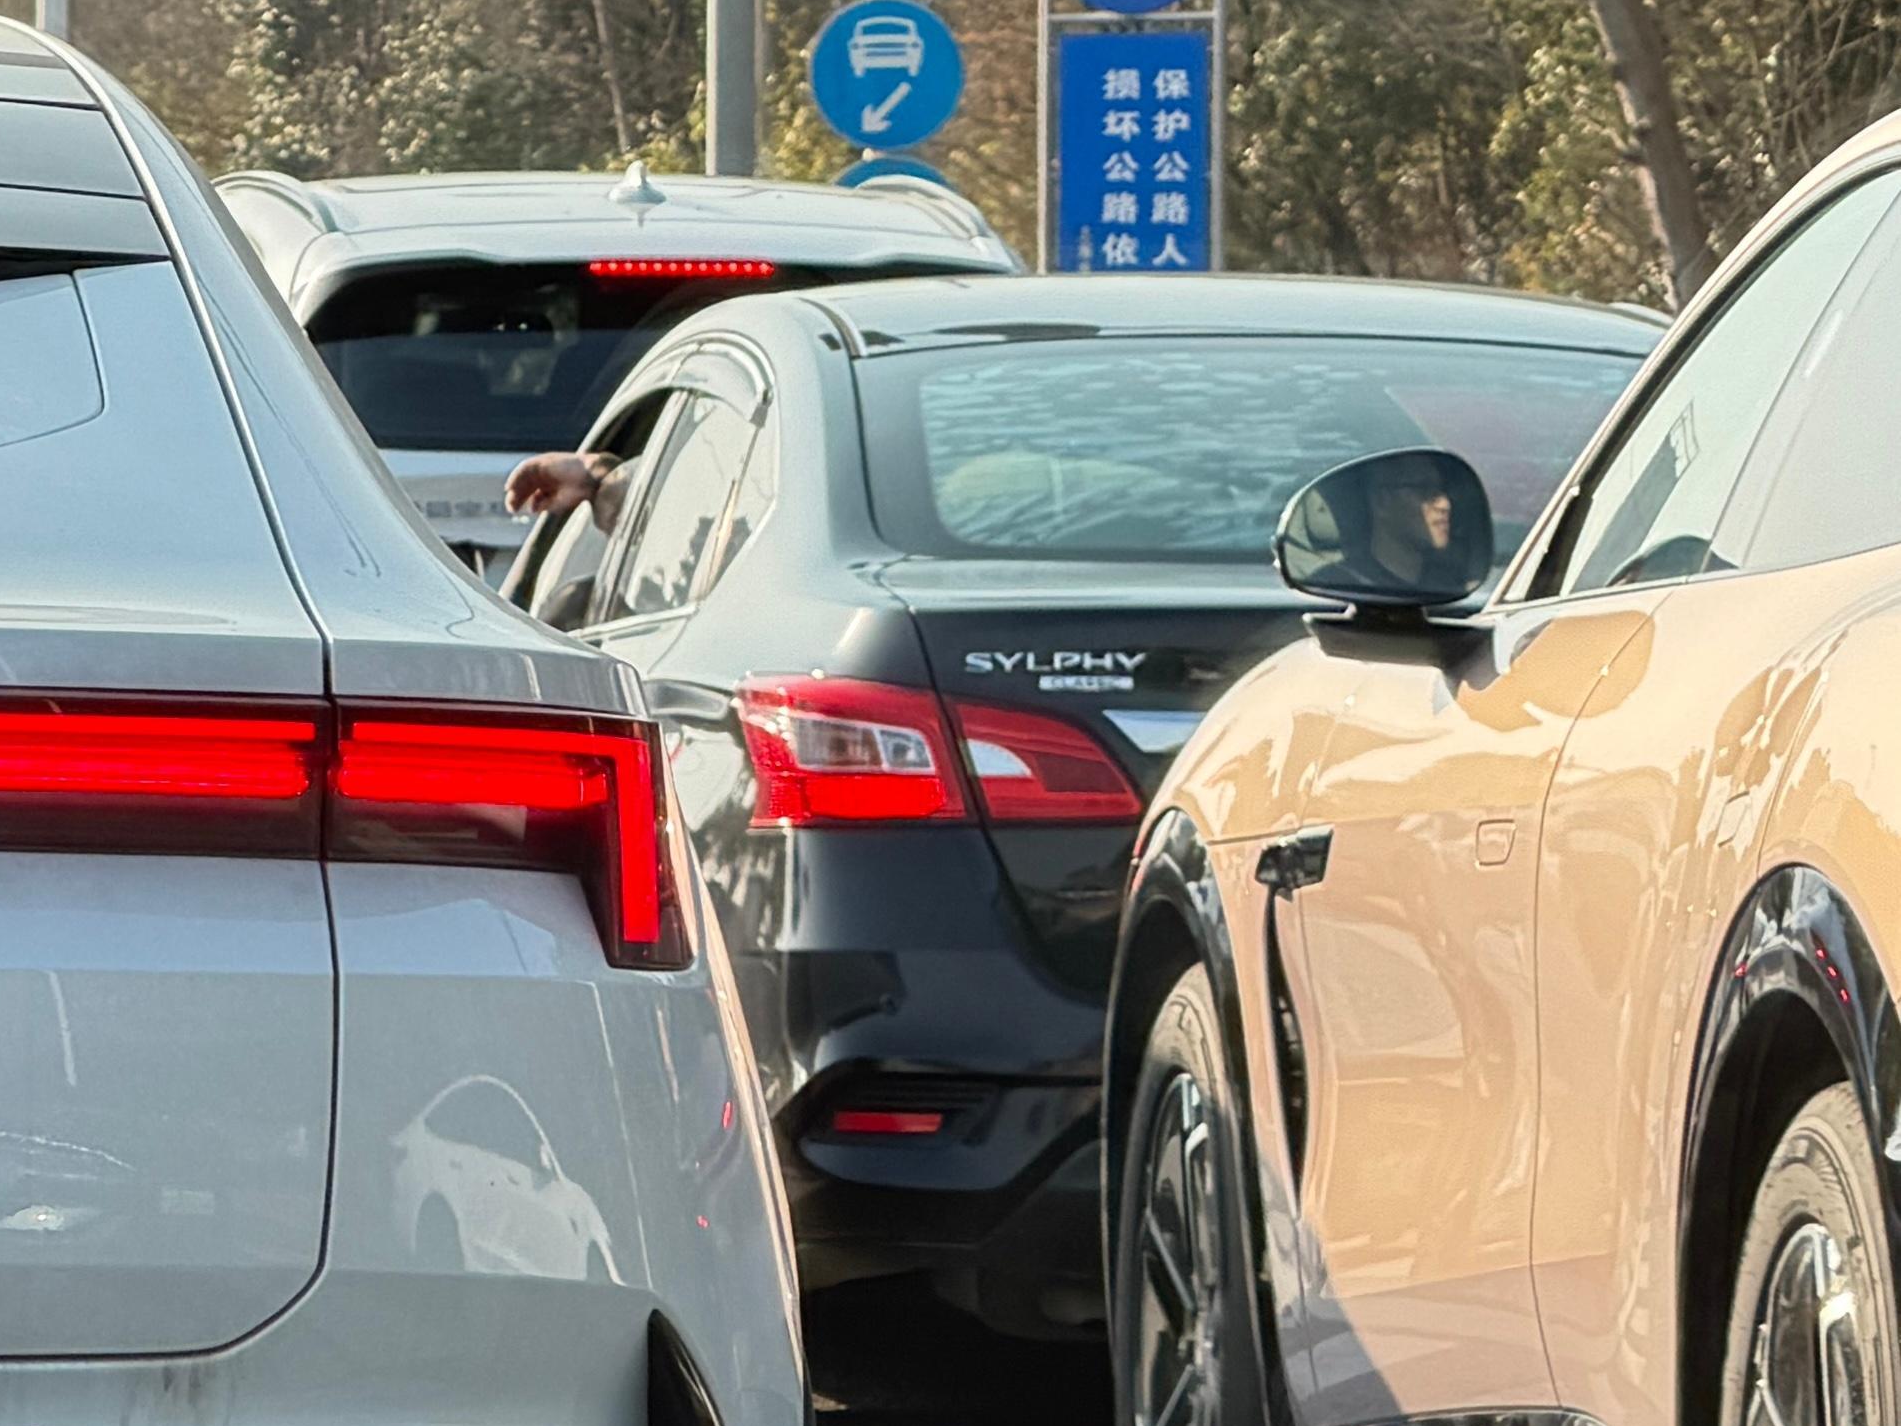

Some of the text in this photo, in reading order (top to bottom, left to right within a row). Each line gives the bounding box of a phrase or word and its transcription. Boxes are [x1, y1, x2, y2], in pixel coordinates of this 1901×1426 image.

[1101, 68, 1141, 266] 损坏公路依
[1151, 68, 1191, 266] 保护公路人
[964, 650, 1147, 673] SYLPHY
